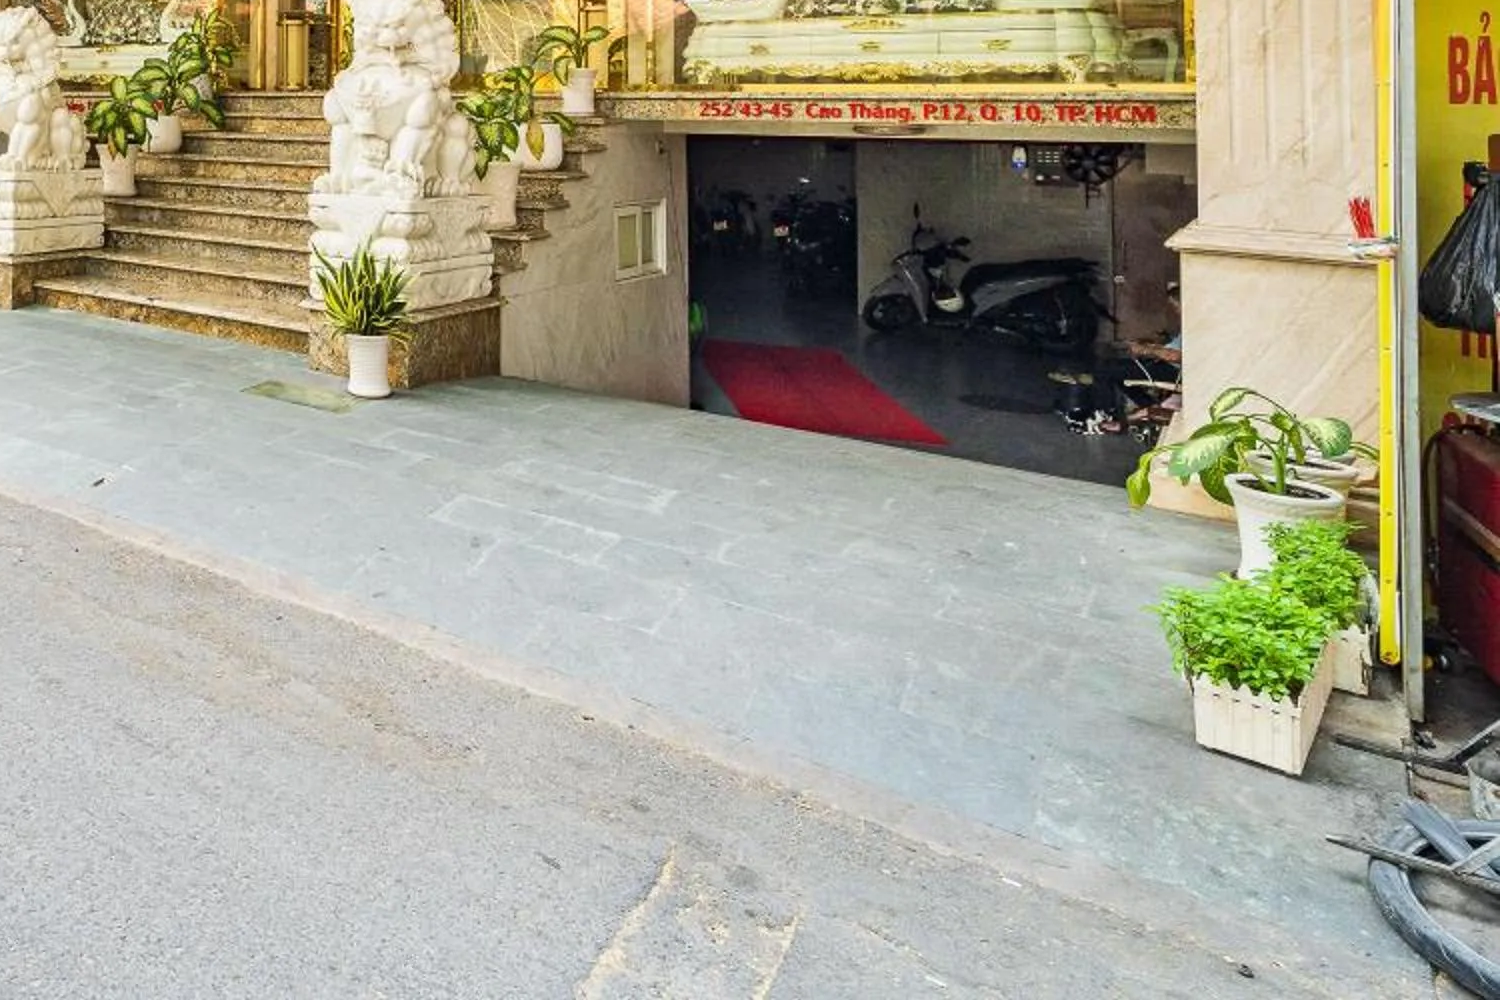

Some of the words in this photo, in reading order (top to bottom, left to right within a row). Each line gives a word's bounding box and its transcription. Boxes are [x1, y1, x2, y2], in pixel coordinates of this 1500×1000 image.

[1449, 11, 1500, 105] BẢ
[805, 102, 843, 119] Cao
[1094, 104, 1157, 123] HCM
